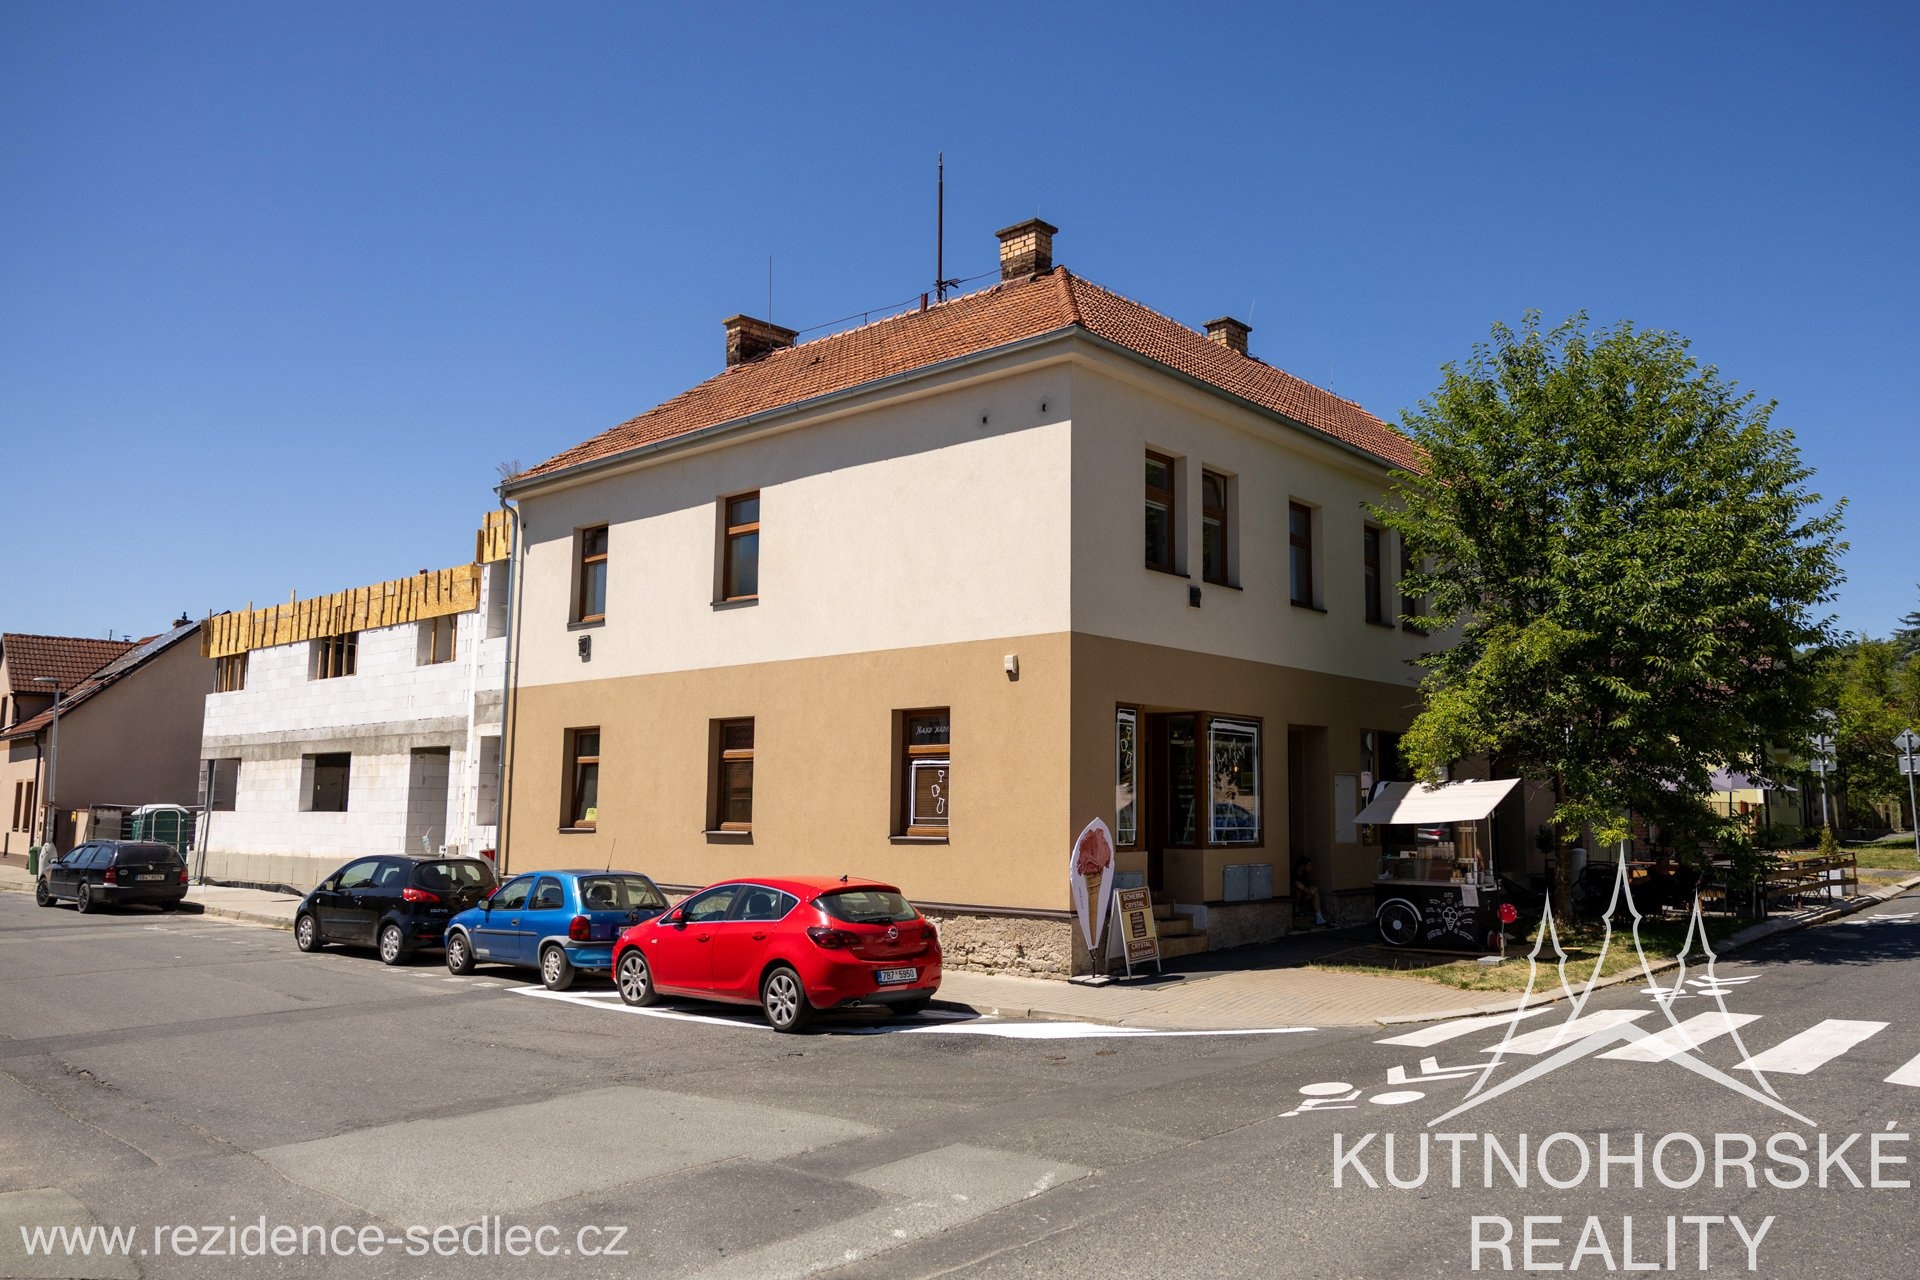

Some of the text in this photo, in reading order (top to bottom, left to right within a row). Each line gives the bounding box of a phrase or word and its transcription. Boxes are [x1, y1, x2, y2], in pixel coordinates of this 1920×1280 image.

[1122, 892, 1145, 901] BOHEMIA
[1125, 901, 1145, 909] CRYSTAL
[1131, 941, 1152, 950] CRYSTAL
